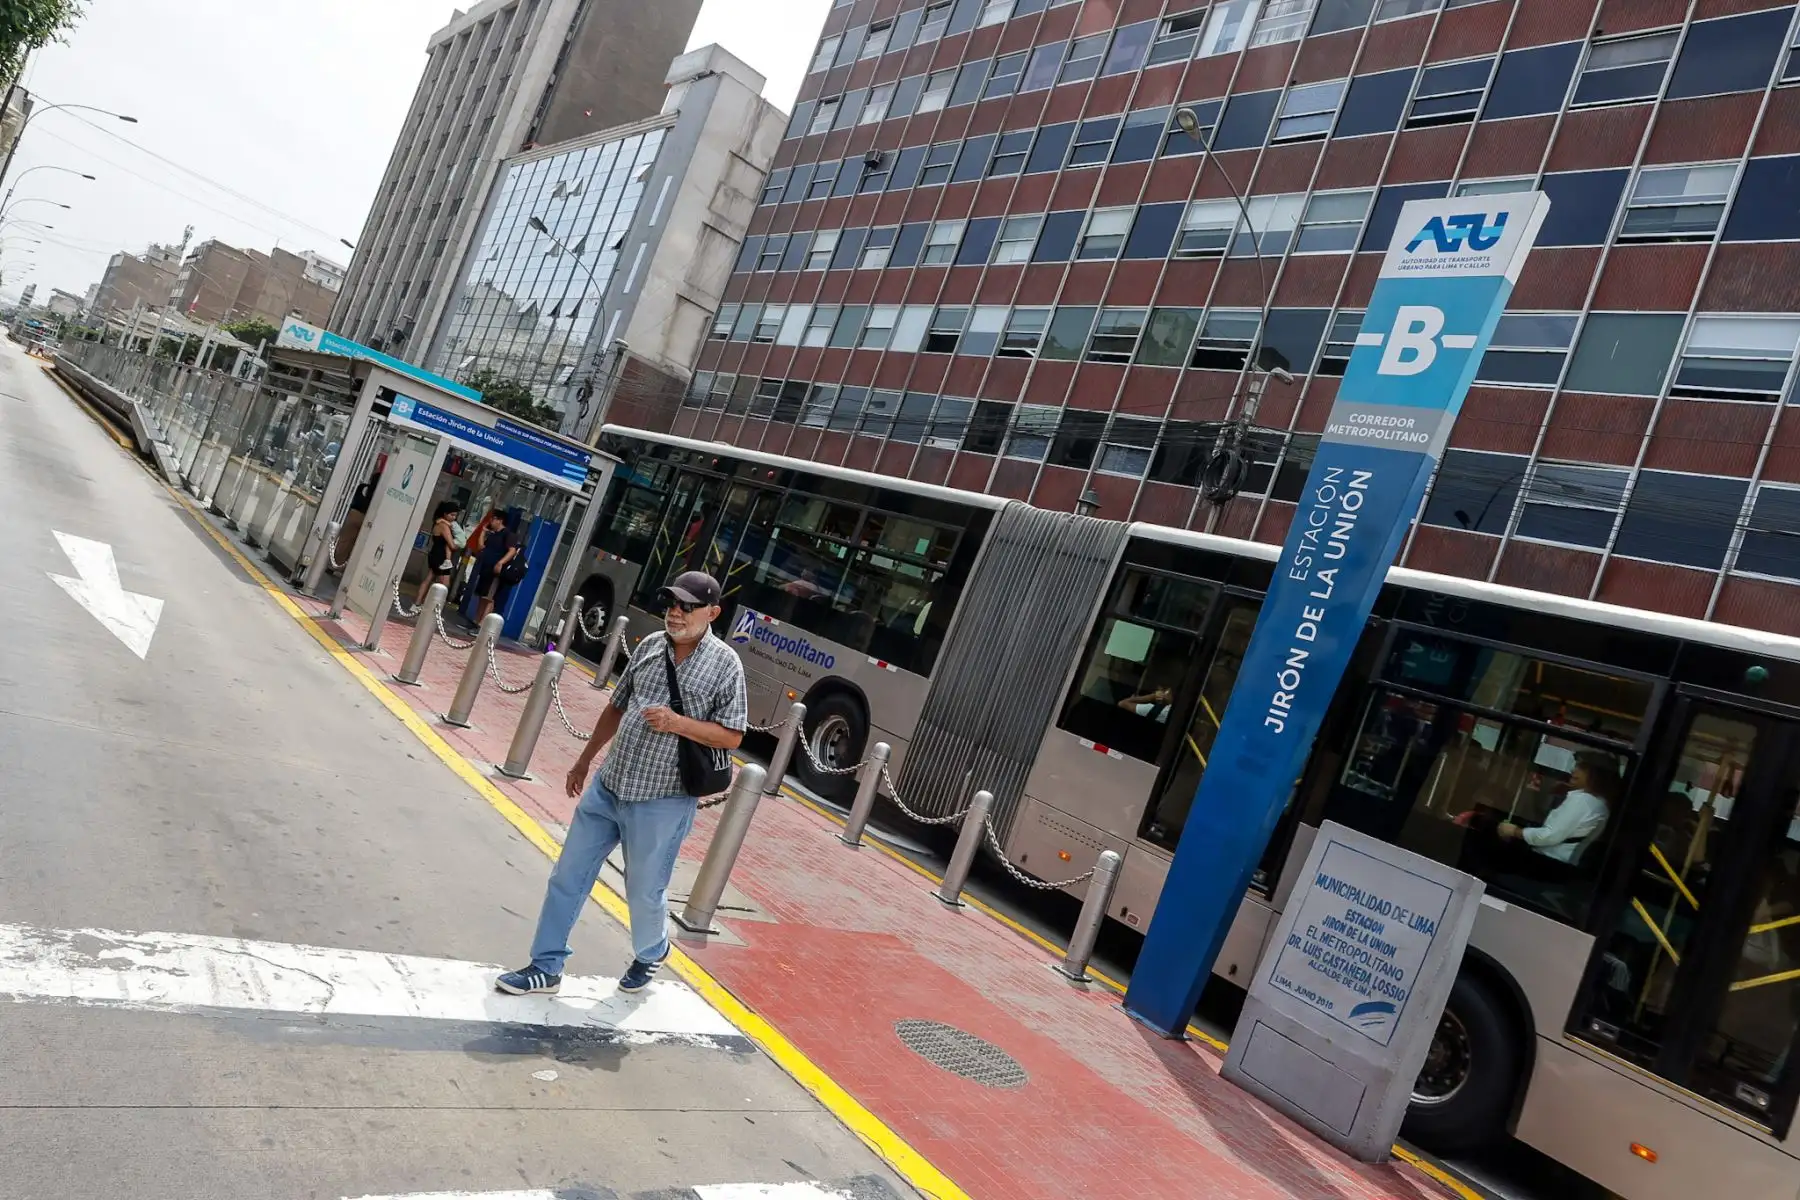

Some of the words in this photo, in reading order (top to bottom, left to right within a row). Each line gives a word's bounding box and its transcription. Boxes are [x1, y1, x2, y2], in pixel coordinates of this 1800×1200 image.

[1404, 211, 1510, 254] ATU
[1401, 256, 1437, 265] AUTORIDAD
[284, 323, 316, 343] ATU
[417, 407, 448, 426] Estación
[447, 416, 467, 433] Jirón
[466, 425, 477, 437] de
[476, 429, 484, 439] la
[483, 431, 505, 447] Unión
[1327, 423, 1429, 444] METROPOLITANO
[1349, 413, 1415, 429] CORREDOR
[1289, 466, 1344, 581] ESTACIÓN
[1323, 470, 1373, 560] UNIÓN
[1310, 567, 1339, 599] LA
[732, 608, 836, 670] Metropolitano
[1296, 604, 1324, 642] DE
[1264, 647, 1309, 734] JIRÓN
[1315, 873, 1391, 917] MUNICIPALIDAD
[1390, 905, 1409, 924] DE
[1407, 912, 1435, 937] LIMA
[1344, 909, 1385, 936] ESTACION
[1306, 925, 1317, 940] EL
[1319, 931, 1404, 982] METROPOLITANO
[1322, 914, 1345, 934] JIRON
[1346, 924, 1359, 940] DE
[1358, 930, 1370, 945] LA
[1369, 935, 1397, 959] UNION
[1288, 934, 1302, 950] DR.
[1302, 940, 1323, 960] LUIS
[1322, 951, 1372, 985] CASTAÑEDA
[1371, 975, 1406, 1002] LOSSIO
[1308, 959, 1341, 983] ALCALDE
[1341, 976, 1354, 989] DE
[1353, 983, 1372, 999] LIMA
[1294, 984, 1317, 1001] JUNIO
